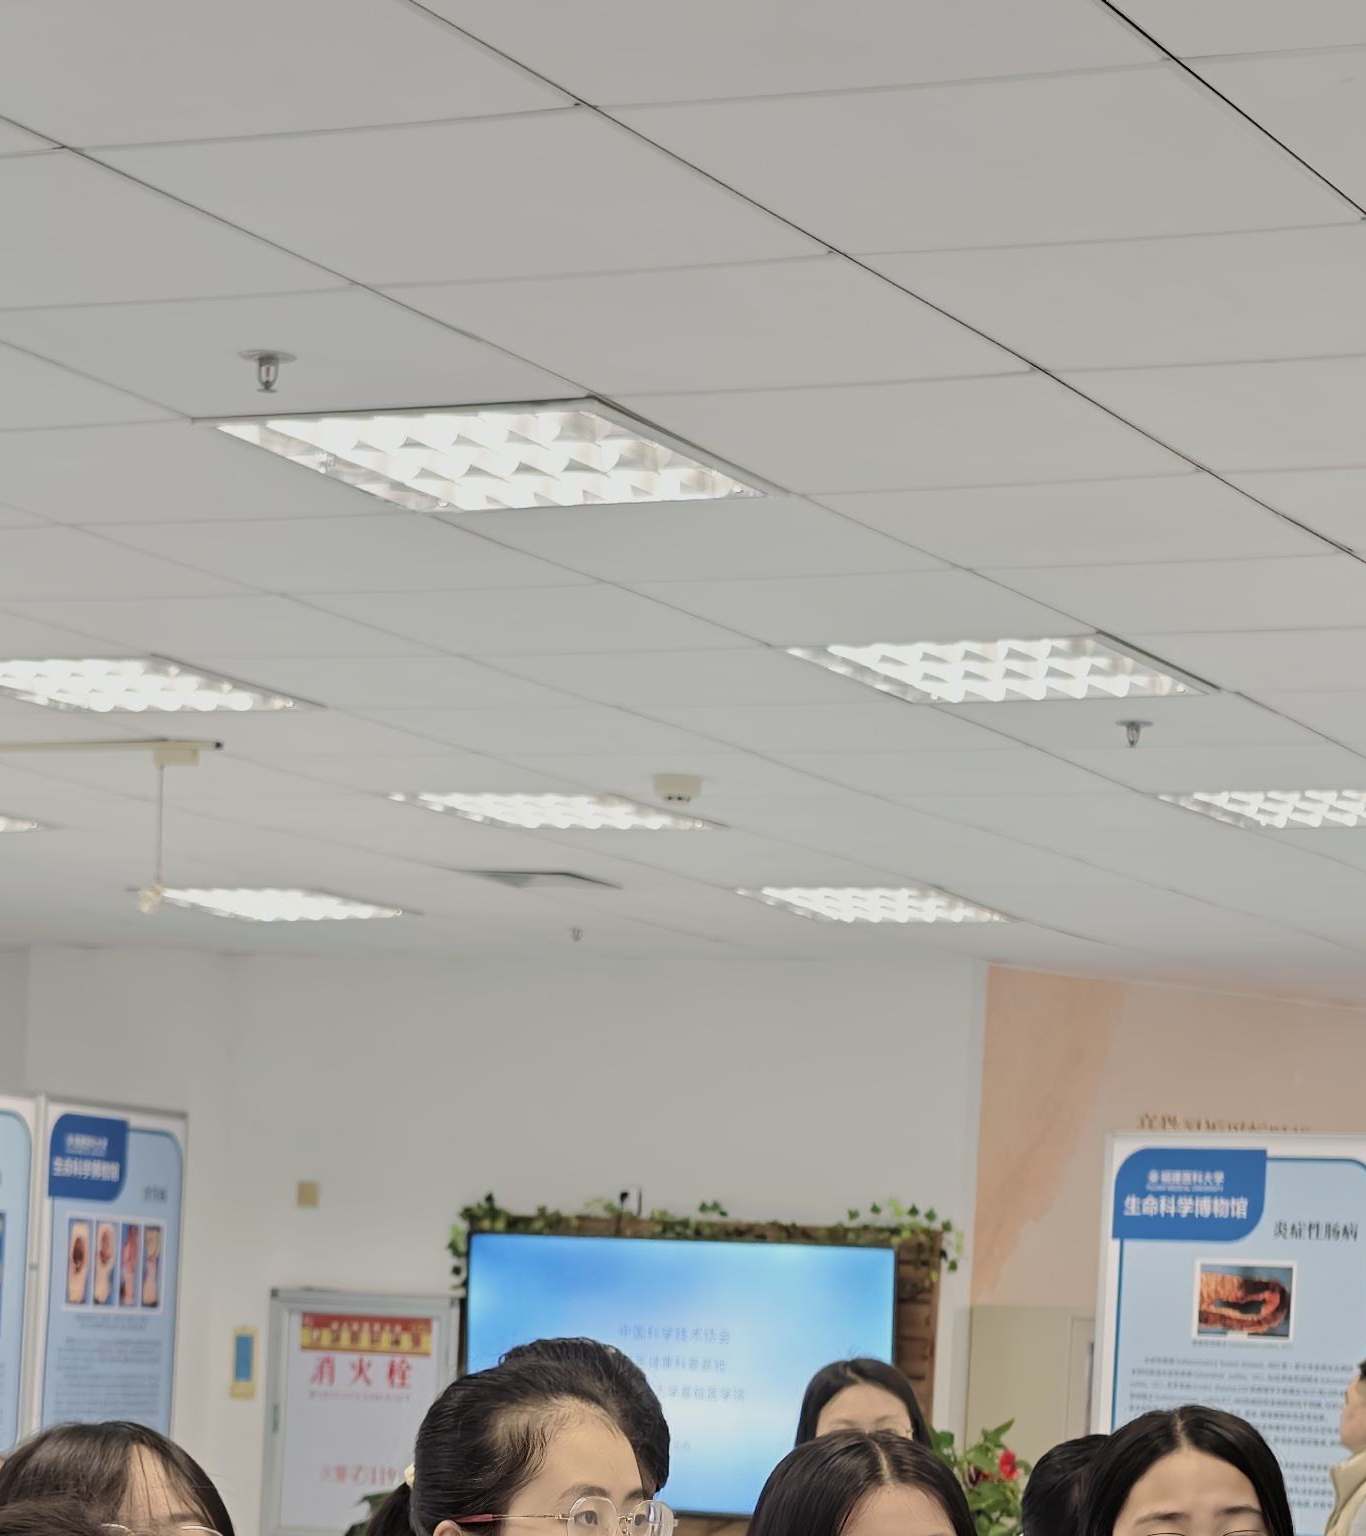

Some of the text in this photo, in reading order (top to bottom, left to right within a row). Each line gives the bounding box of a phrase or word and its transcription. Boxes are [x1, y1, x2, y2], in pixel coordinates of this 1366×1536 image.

[1123, 1194, 1248, 1219] 生命科学博物馆
[1274, 1220, 1358, 1241] 炎症性肠病
[311, 1355, 412, 1389] 消火栓
[369, 1467, 397, 1486] 119
